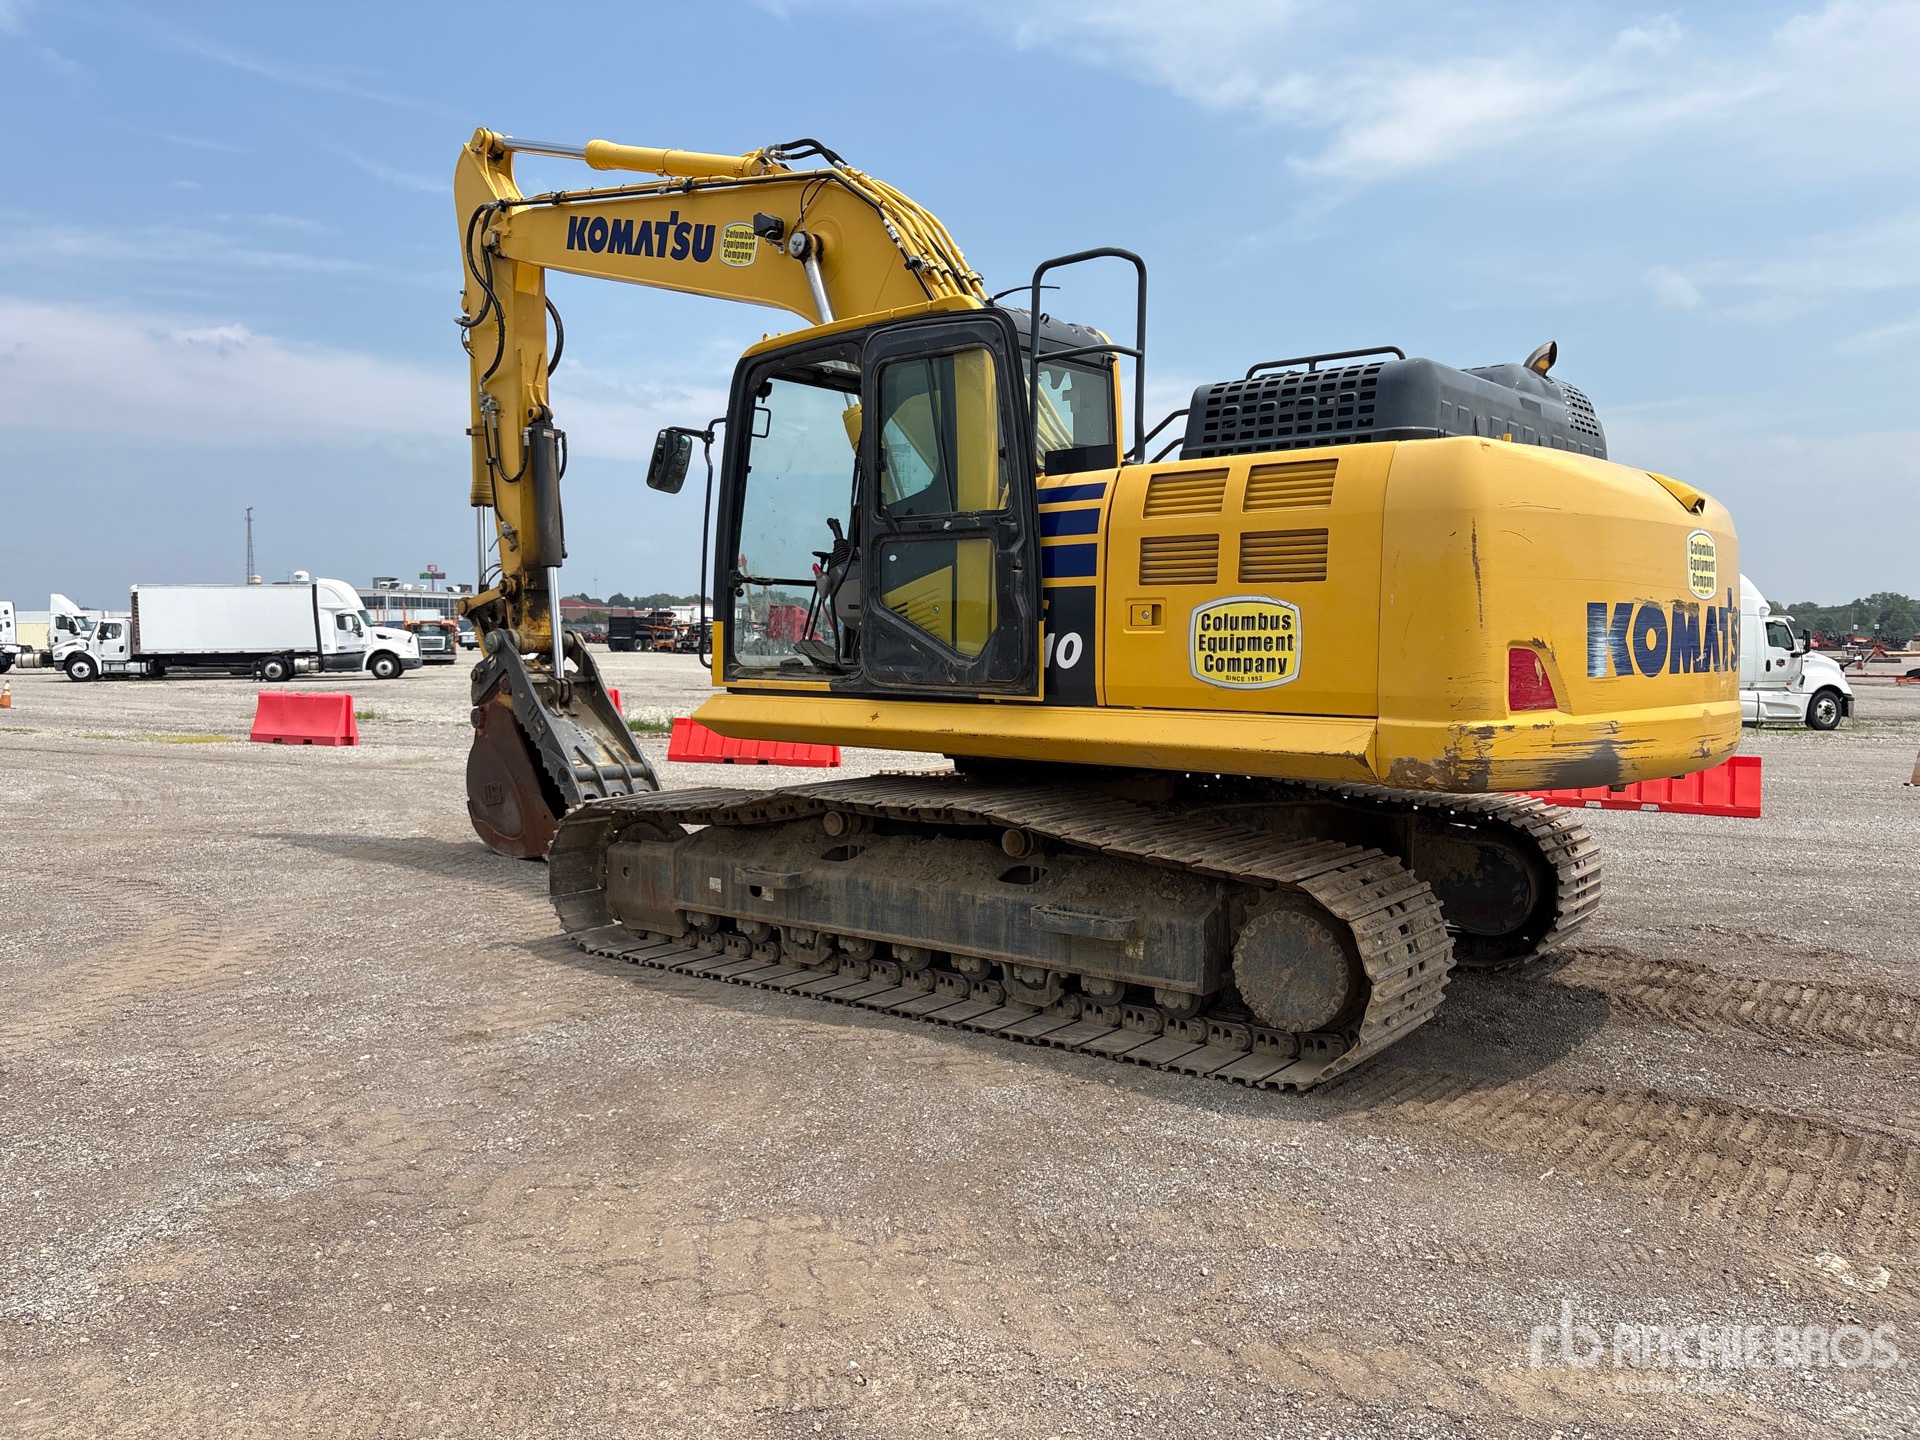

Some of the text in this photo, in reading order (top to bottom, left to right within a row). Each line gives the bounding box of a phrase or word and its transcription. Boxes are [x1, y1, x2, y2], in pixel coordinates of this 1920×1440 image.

[566, 211, 716, 263] KOMATSU
[725, 229, 756, 240] Columbus
[723, 239, 756, 250] Equipment
[724, 249, 752, 261] Company
[1690, 541, 1715, 557] Columbus
[1690, 557, 1715, 573] Equipment
[1692, 573, 1715, 589] Company
[1201, 612, 1292, 632] Columbus
[1586, 588, 1740, 678] KOMATS
[1198, 634, 1294, 653] Equipment
[1204, 654, 1287, 675] Company
